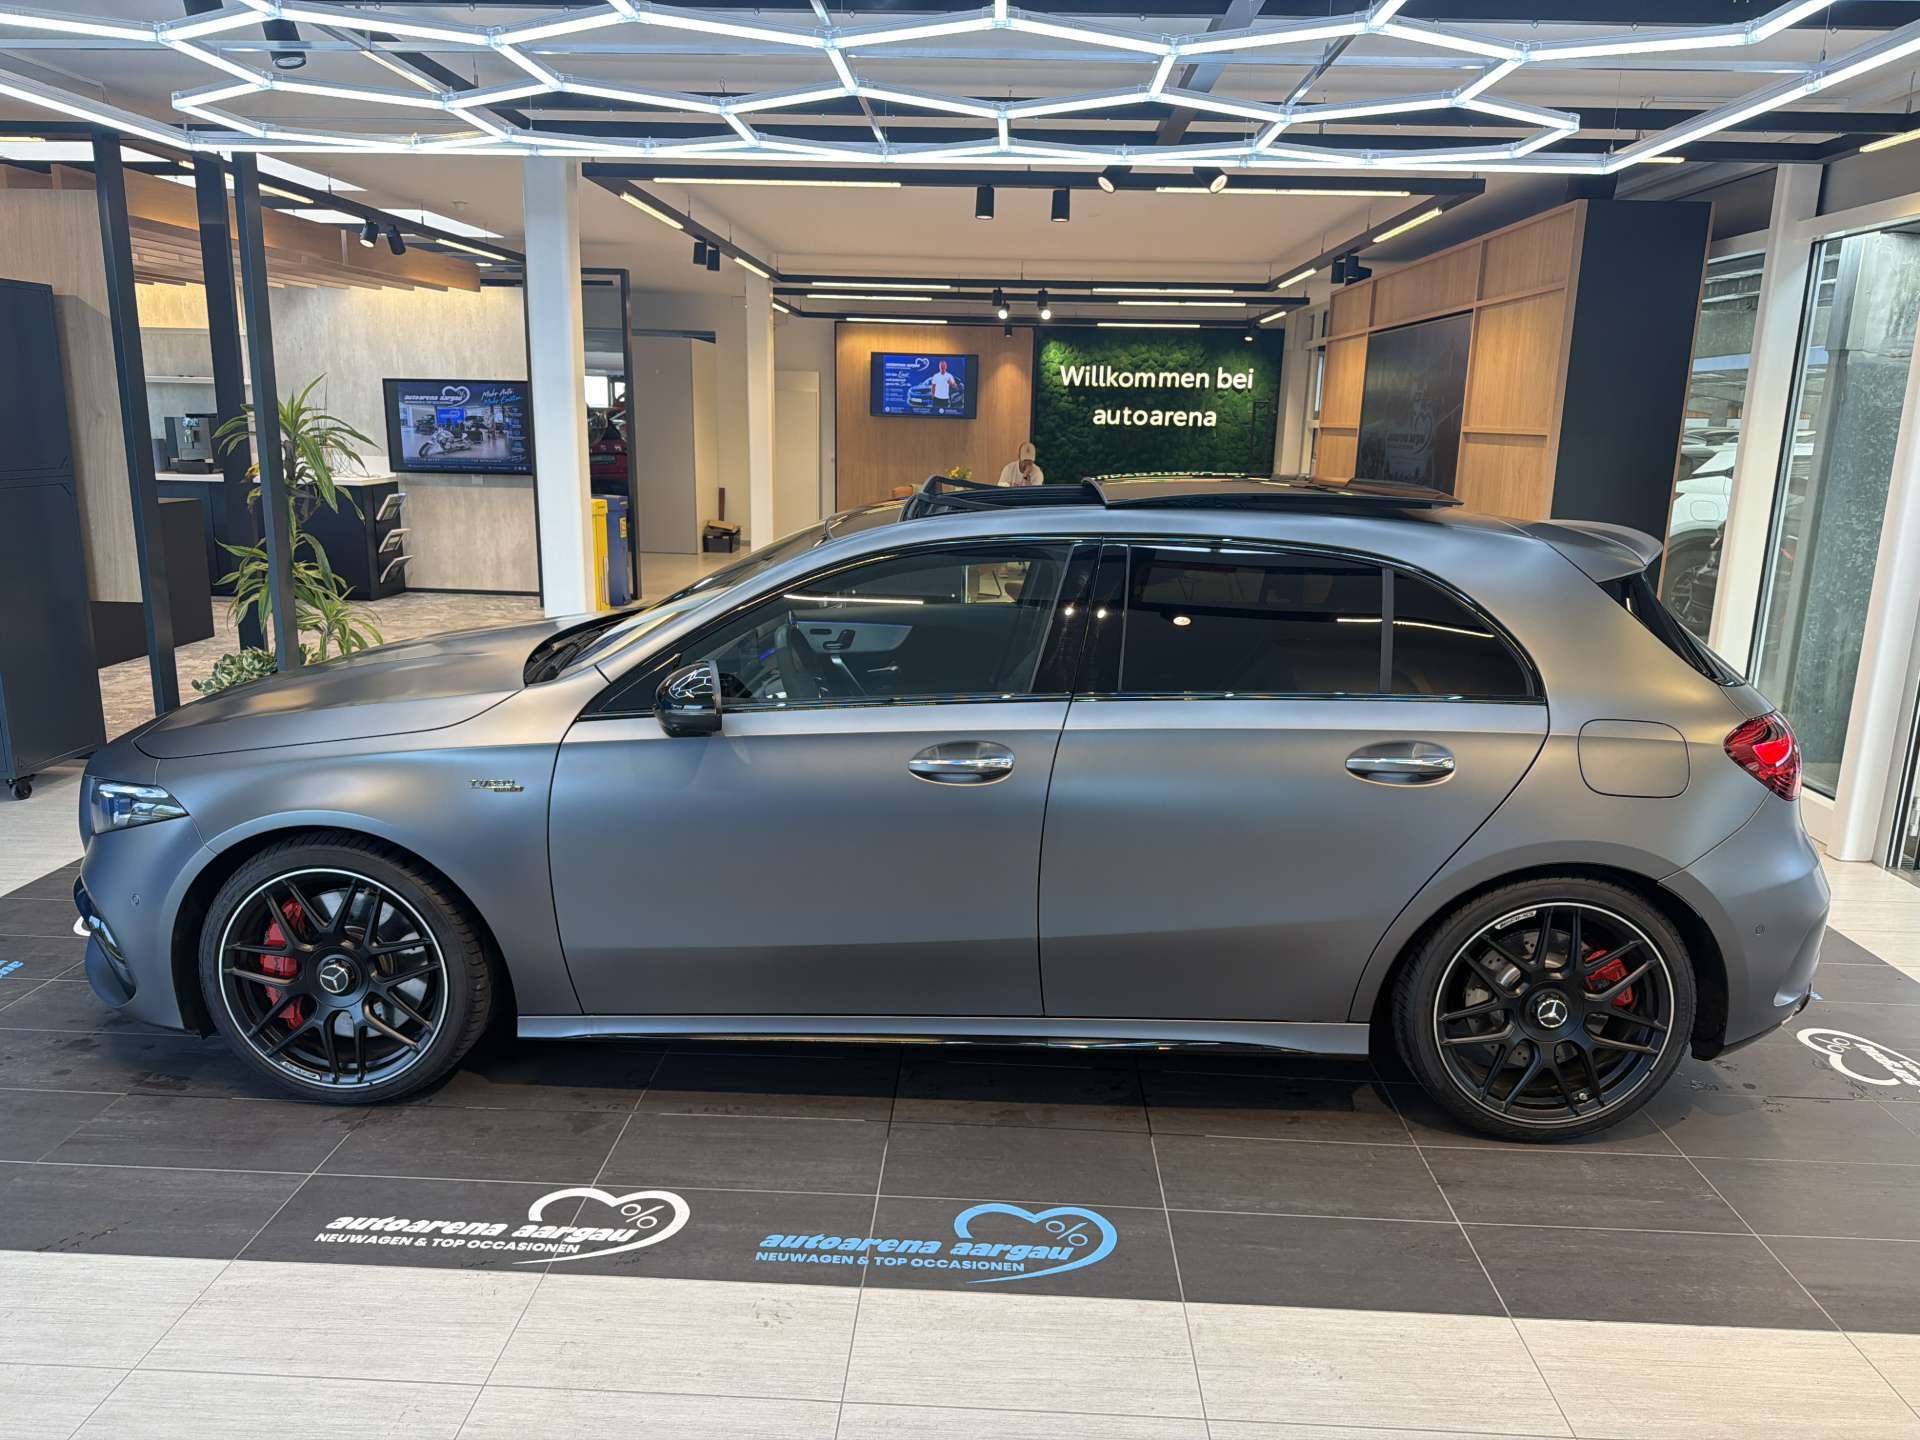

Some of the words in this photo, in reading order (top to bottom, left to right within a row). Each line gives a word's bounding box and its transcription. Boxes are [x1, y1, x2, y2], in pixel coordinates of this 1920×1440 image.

[1060, 365, 1210, 389] Willkommen
[1216, 366, 1255, 390] bei
[1092, 406, 1217, 427] autoarena
[325, 1215, 509, 1237] autoarena
[511, 1222, 641, 1243] aargau
[314, 1233, 413, 1246] NEUWAGEN
[414, 1236, 427, 1247] &
[431, 1238, 466, 1249] TOP
[466, 1239, 581, 1254] OCCASIONEN
[760, 1233, 942, 1254] autoarena
[950, 1243, 1075, 1262] aargau
[755, 1251, 854, 1266] NEUWAGEN
[857, 1255, 869, 1265] &
[873, 1257, 908, 1267] TOP
[910, 1258, 1026, 1272] OCCASIONEN
